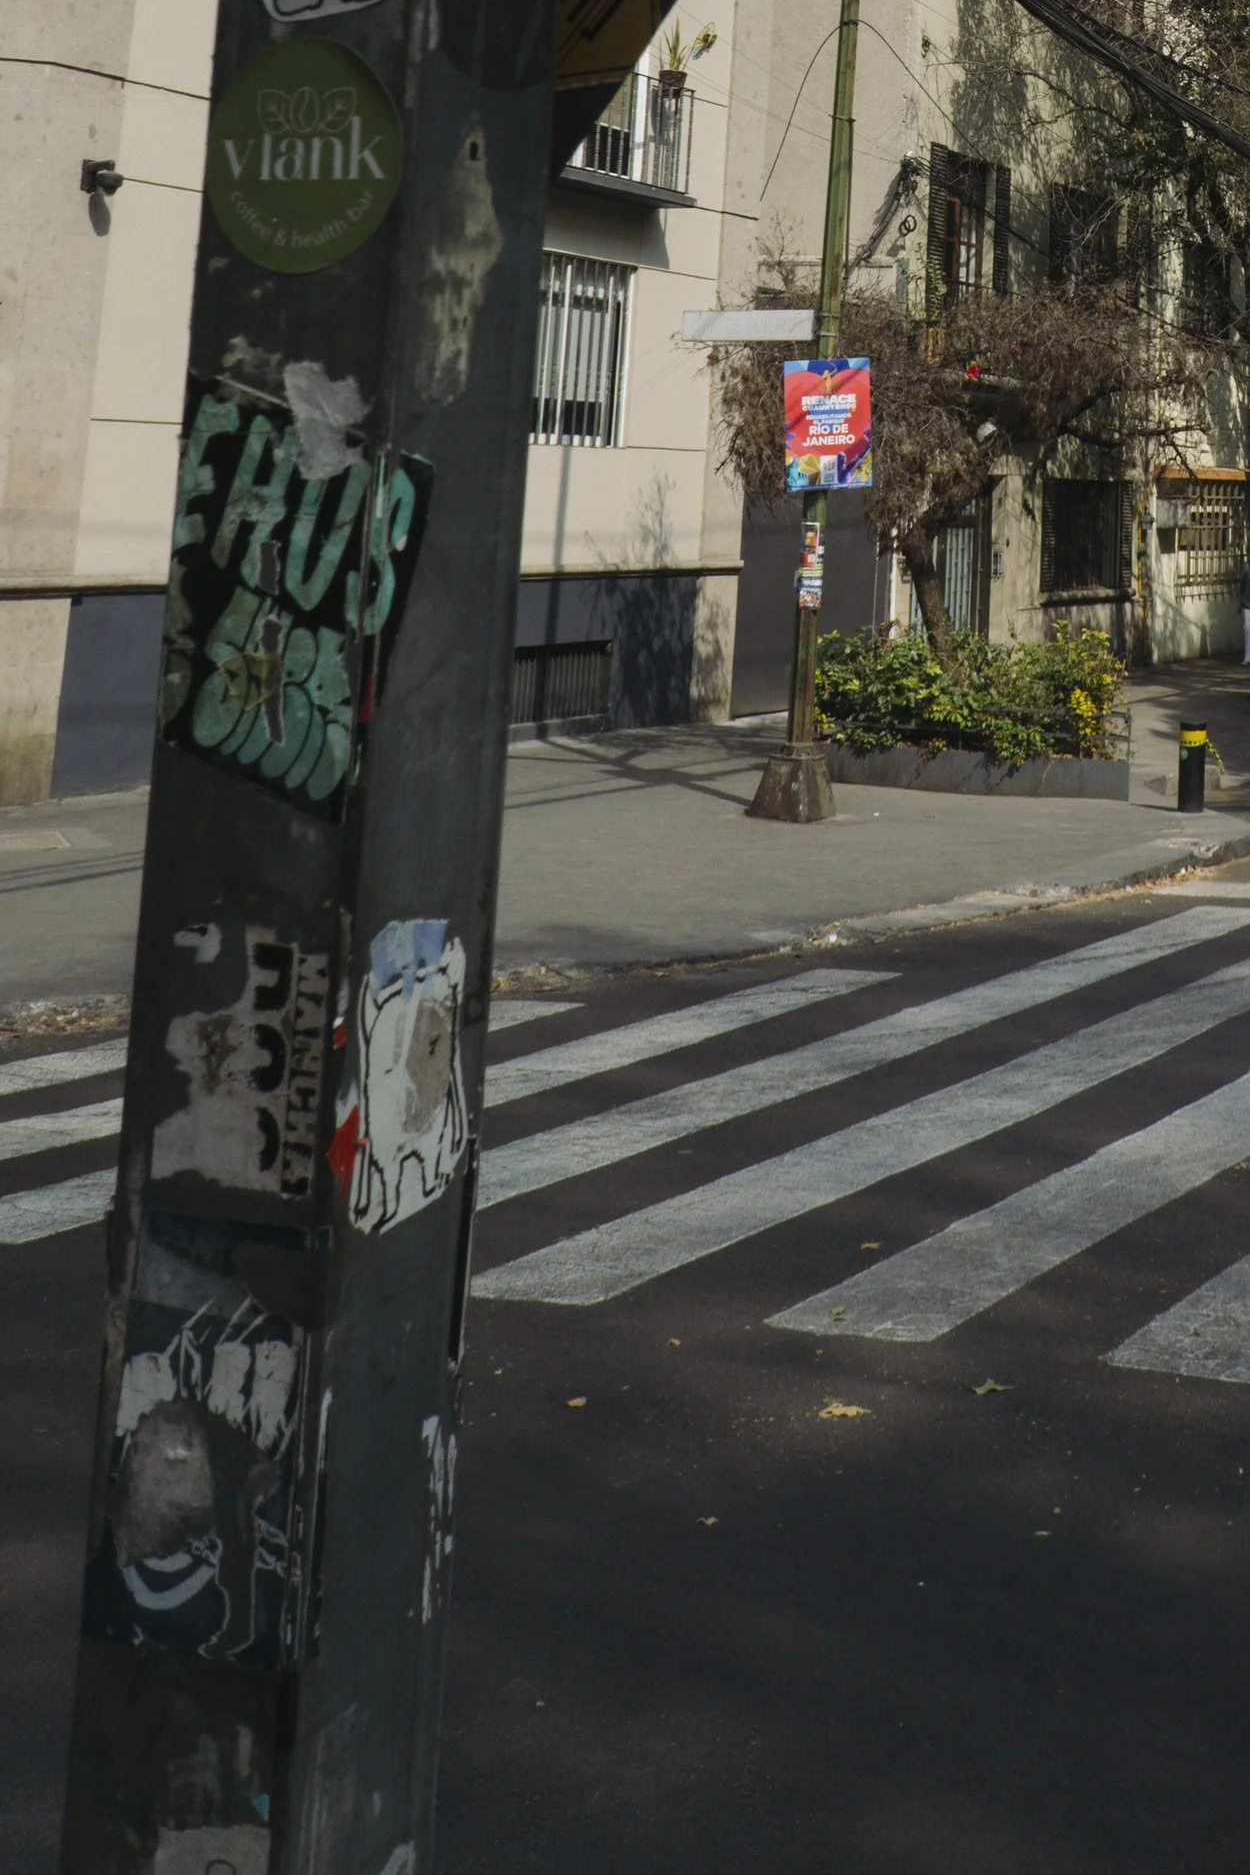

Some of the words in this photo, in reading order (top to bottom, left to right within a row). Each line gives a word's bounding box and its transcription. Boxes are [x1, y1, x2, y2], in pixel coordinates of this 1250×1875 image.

[230, 190, 273, 241] coffee
[273, 227, 287, 247] &
[290, 218, 348, 249] health
[344, 188, 375, 222] bar
[801, 393, 857, 406] RENACE
[832, 424, 848, 434] DE
[802, 434, 856, 447] JANEIRO
